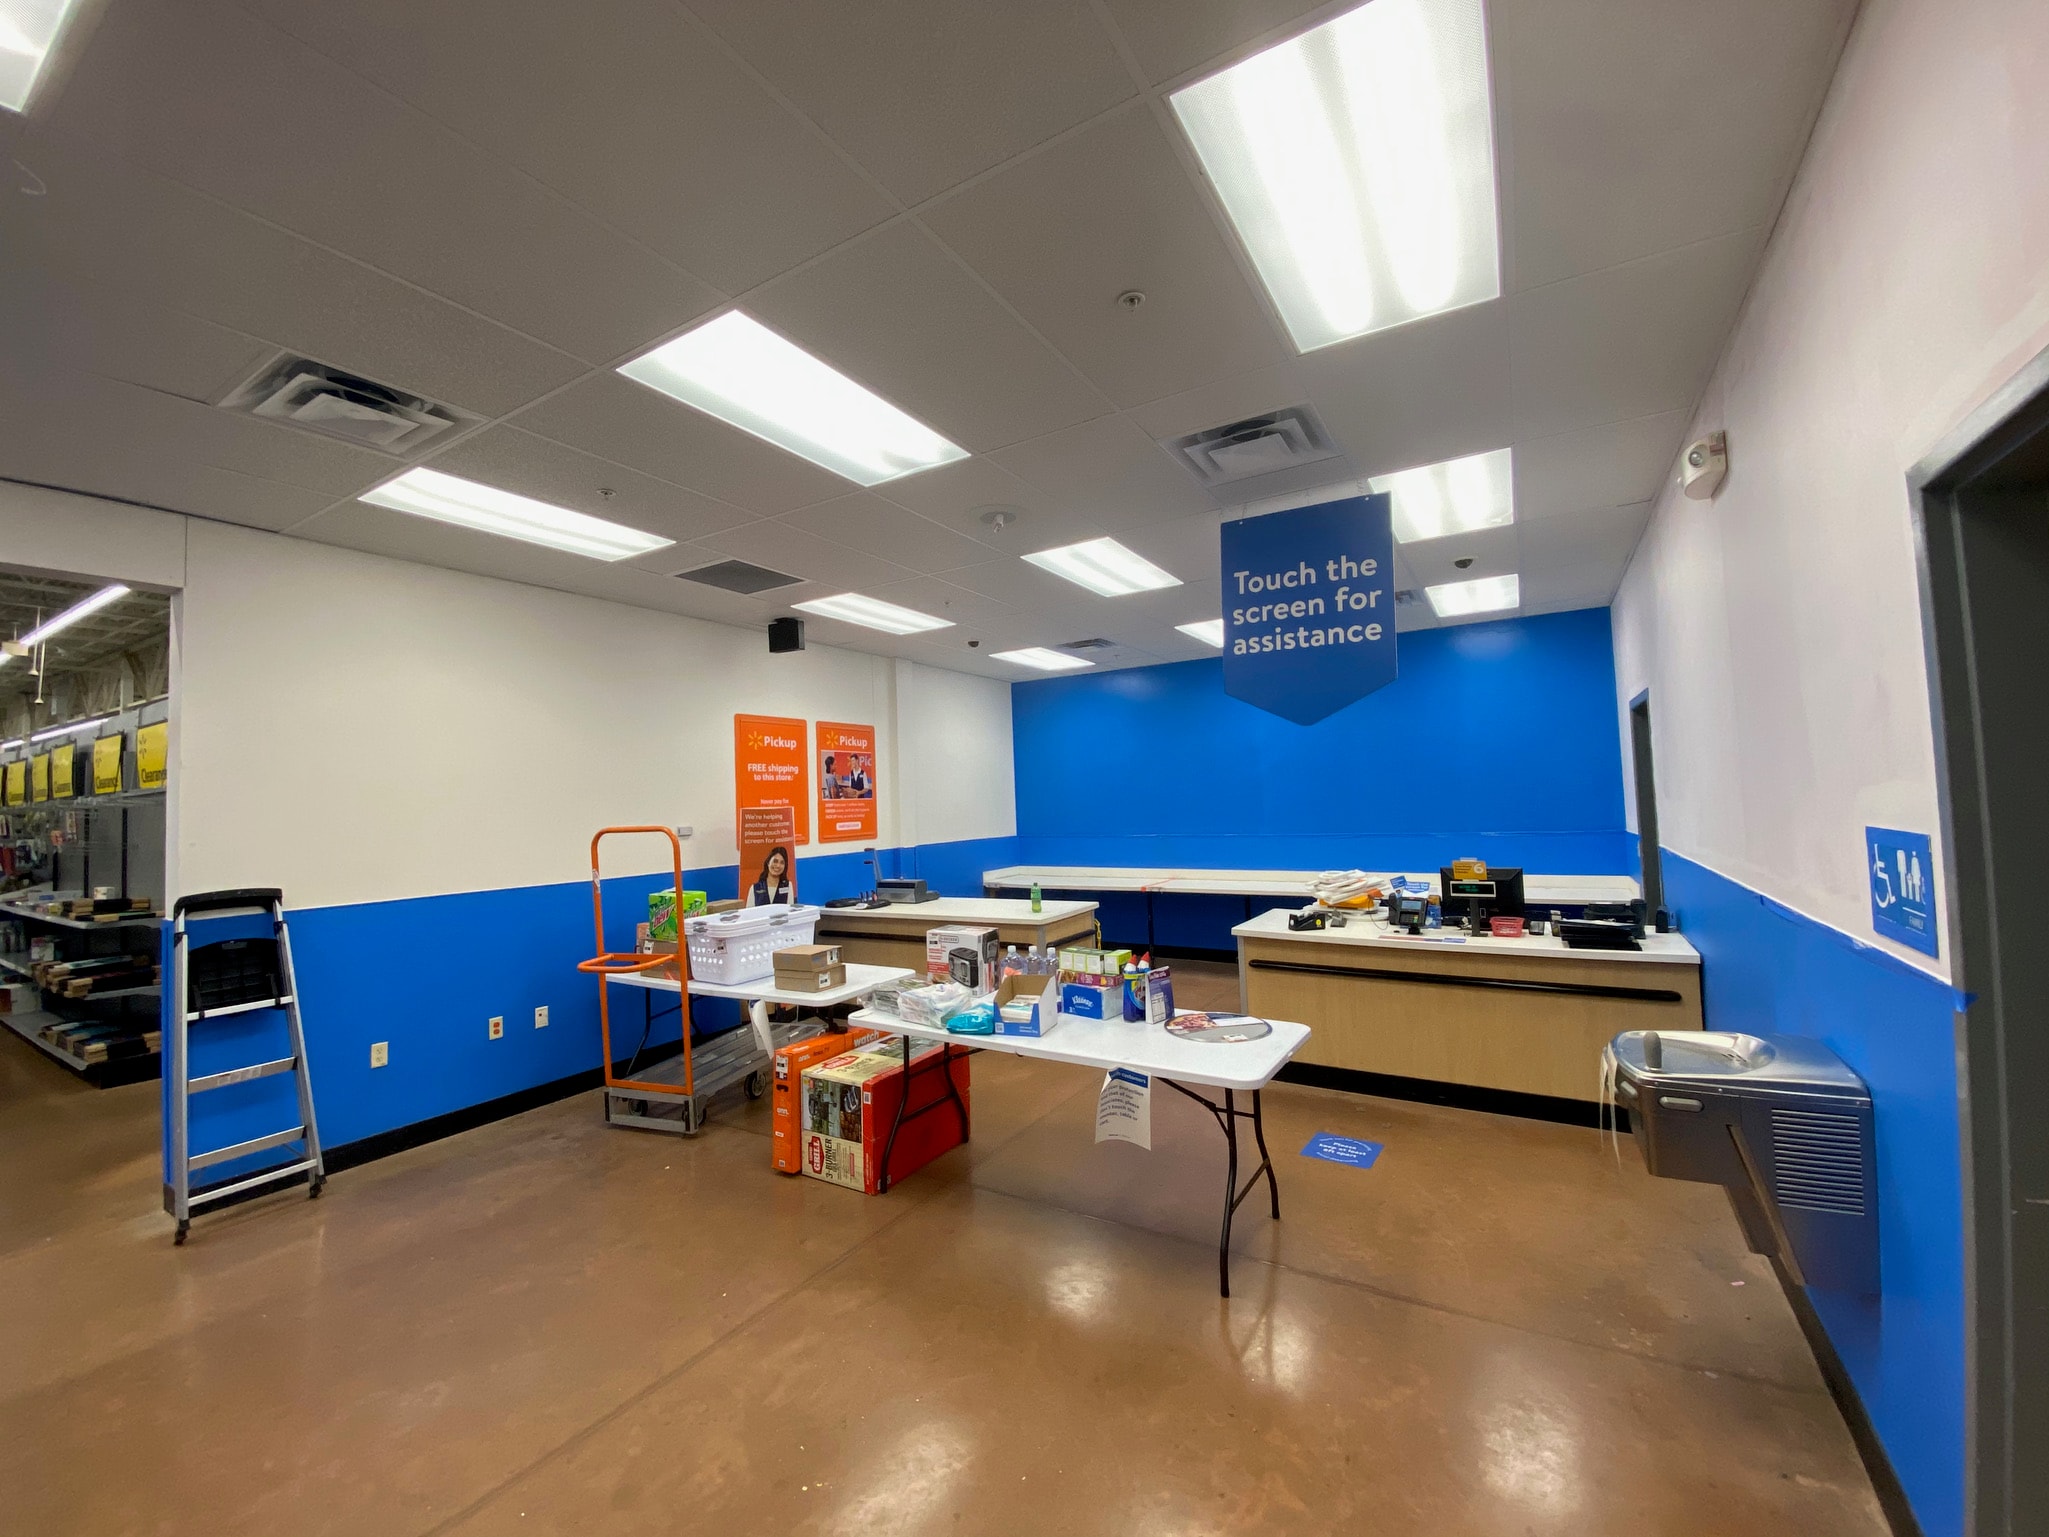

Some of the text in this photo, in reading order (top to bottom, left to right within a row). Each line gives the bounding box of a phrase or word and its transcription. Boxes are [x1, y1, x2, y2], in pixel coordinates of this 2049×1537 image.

[1233, 555, 1378, 595] Touch the
[1233, 586, 1382, 626] screen for
[1233, 622, 1383, 656] assistance
[764, 735, 797, 751] Pickup
[840, 735, 868, 750] Pickup
[747, 763, 799, 775] FREE shipping
[754, 773, 762, 781] to
[762, 773, 775, 781] this
[763, 813, 783, 821] helping
[1473, 863, 1484, 875] 6
[853, 1029, 880, 1048] watch
